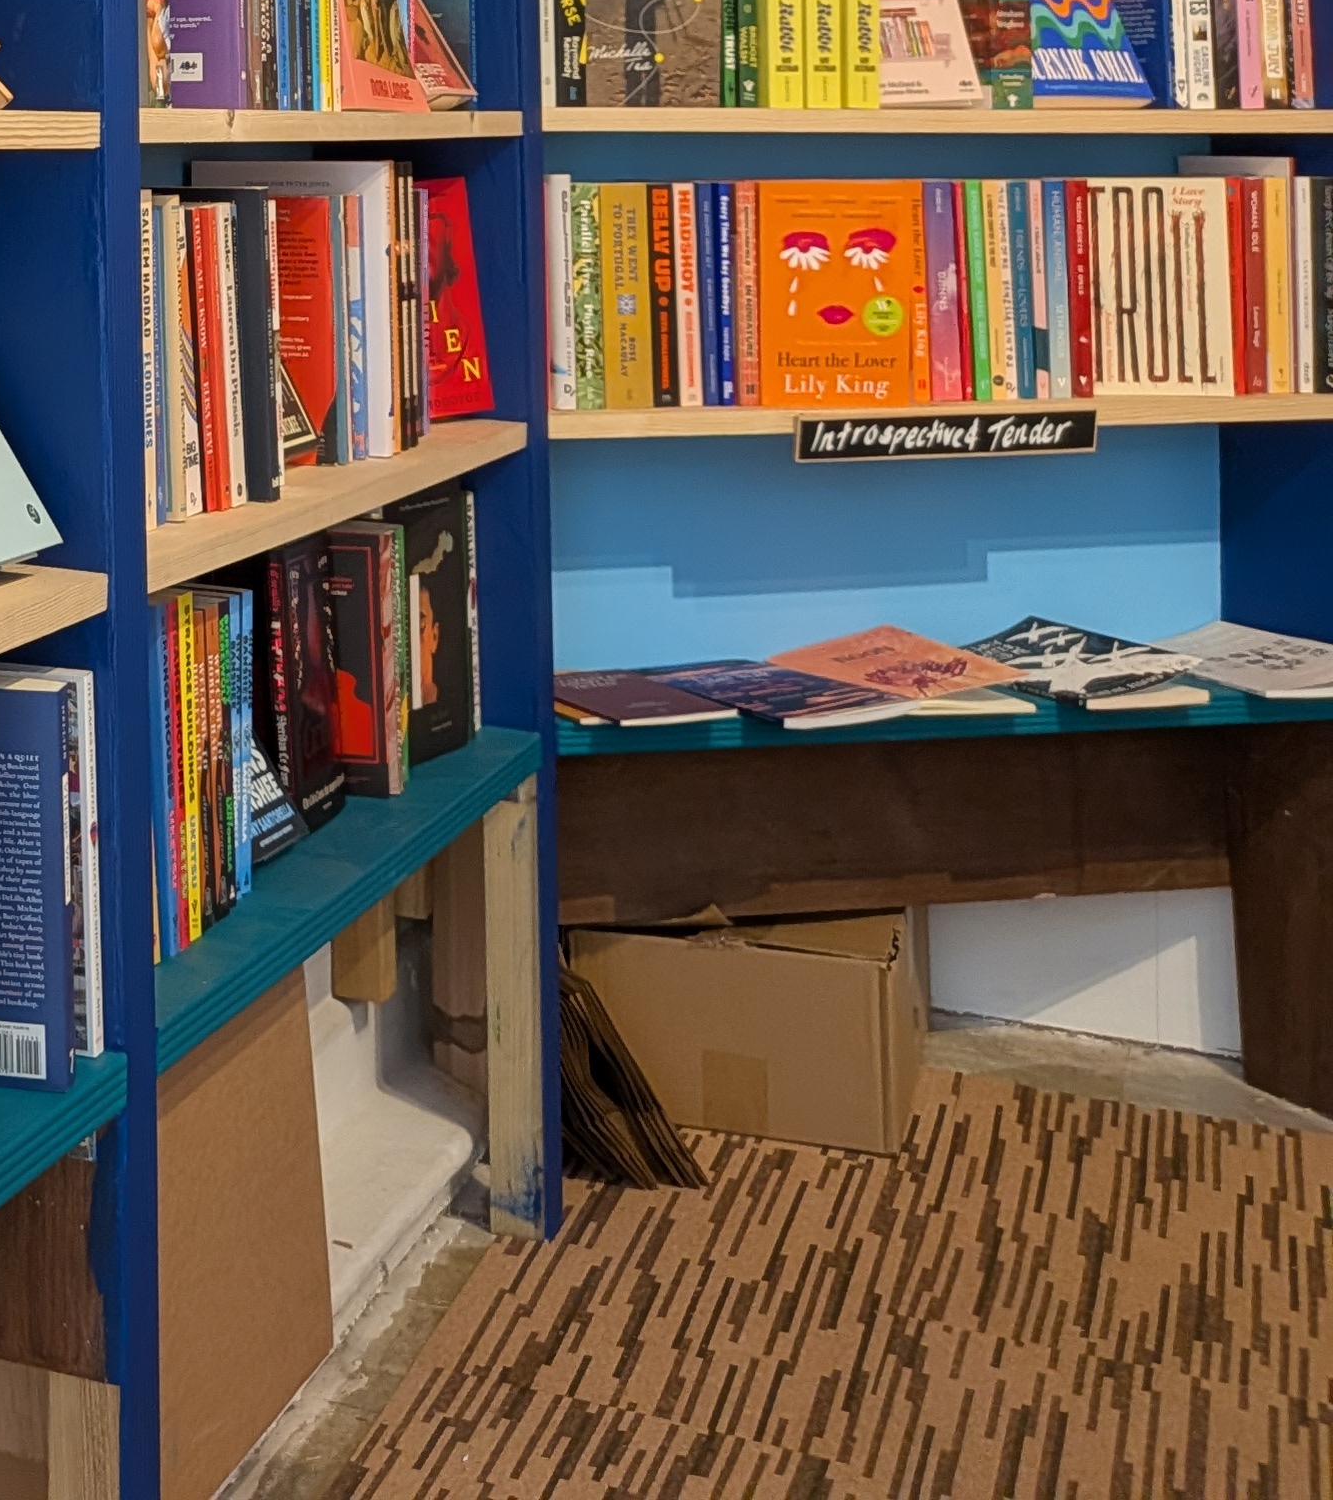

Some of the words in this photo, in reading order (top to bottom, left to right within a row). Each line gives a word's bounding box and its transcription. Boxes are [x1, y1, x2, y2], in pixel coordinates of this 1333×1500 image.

[142, 207, 150, 271] SALEEM
[652, 187, 670, 259] BELLY
[677, 189, 694, 293] HEADSHOT
[143, 272, 152, 339] HADDAD
[654, 258, 672, 293] UP
[1086, 185, 1217, 384] TROLL
[777, 351, 821, 370] Heart
[824, 351, 849, 369] the
[851, 351, 898, 370] Lover
[783, 373, 829, 401] Lily
[835, 373, 891, 398] King
[144, 352, 153, 451] FLOODLINES
[987, 415, 1074, 452] Tender
